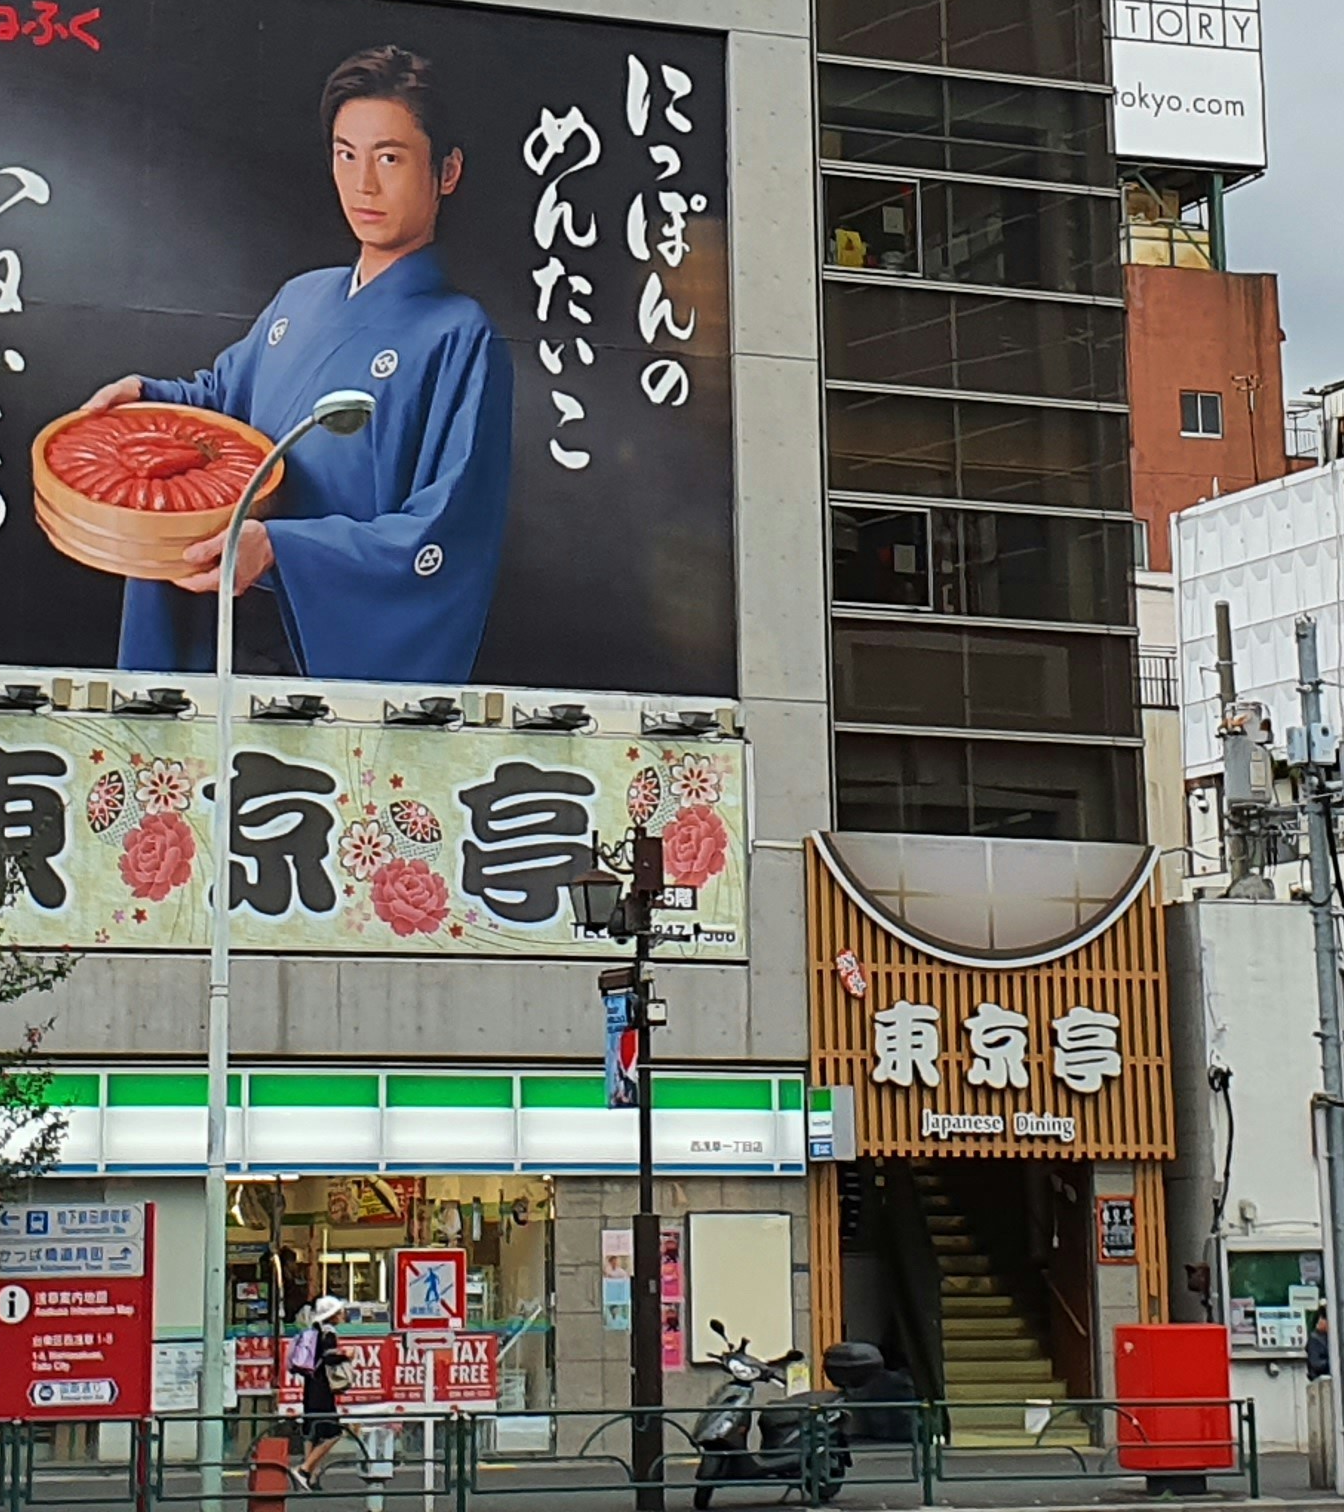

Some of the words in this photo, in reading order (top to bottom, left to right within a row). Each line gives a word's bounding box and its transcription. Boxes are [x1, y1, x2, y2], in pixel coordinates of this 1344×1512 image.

[626, 53, 710, 409] にっぽんの
[522, 107, 601, 472] めんたいこ
[872, 1000, 1122, 1094] 東京亭
[921, 1108, 1005, 1135] Japanese
[1013, 1109, 1076, 1142] Dining
[449, 1364, 490, 1384] FREE
[452, 1340, 489, 1364] TAX
